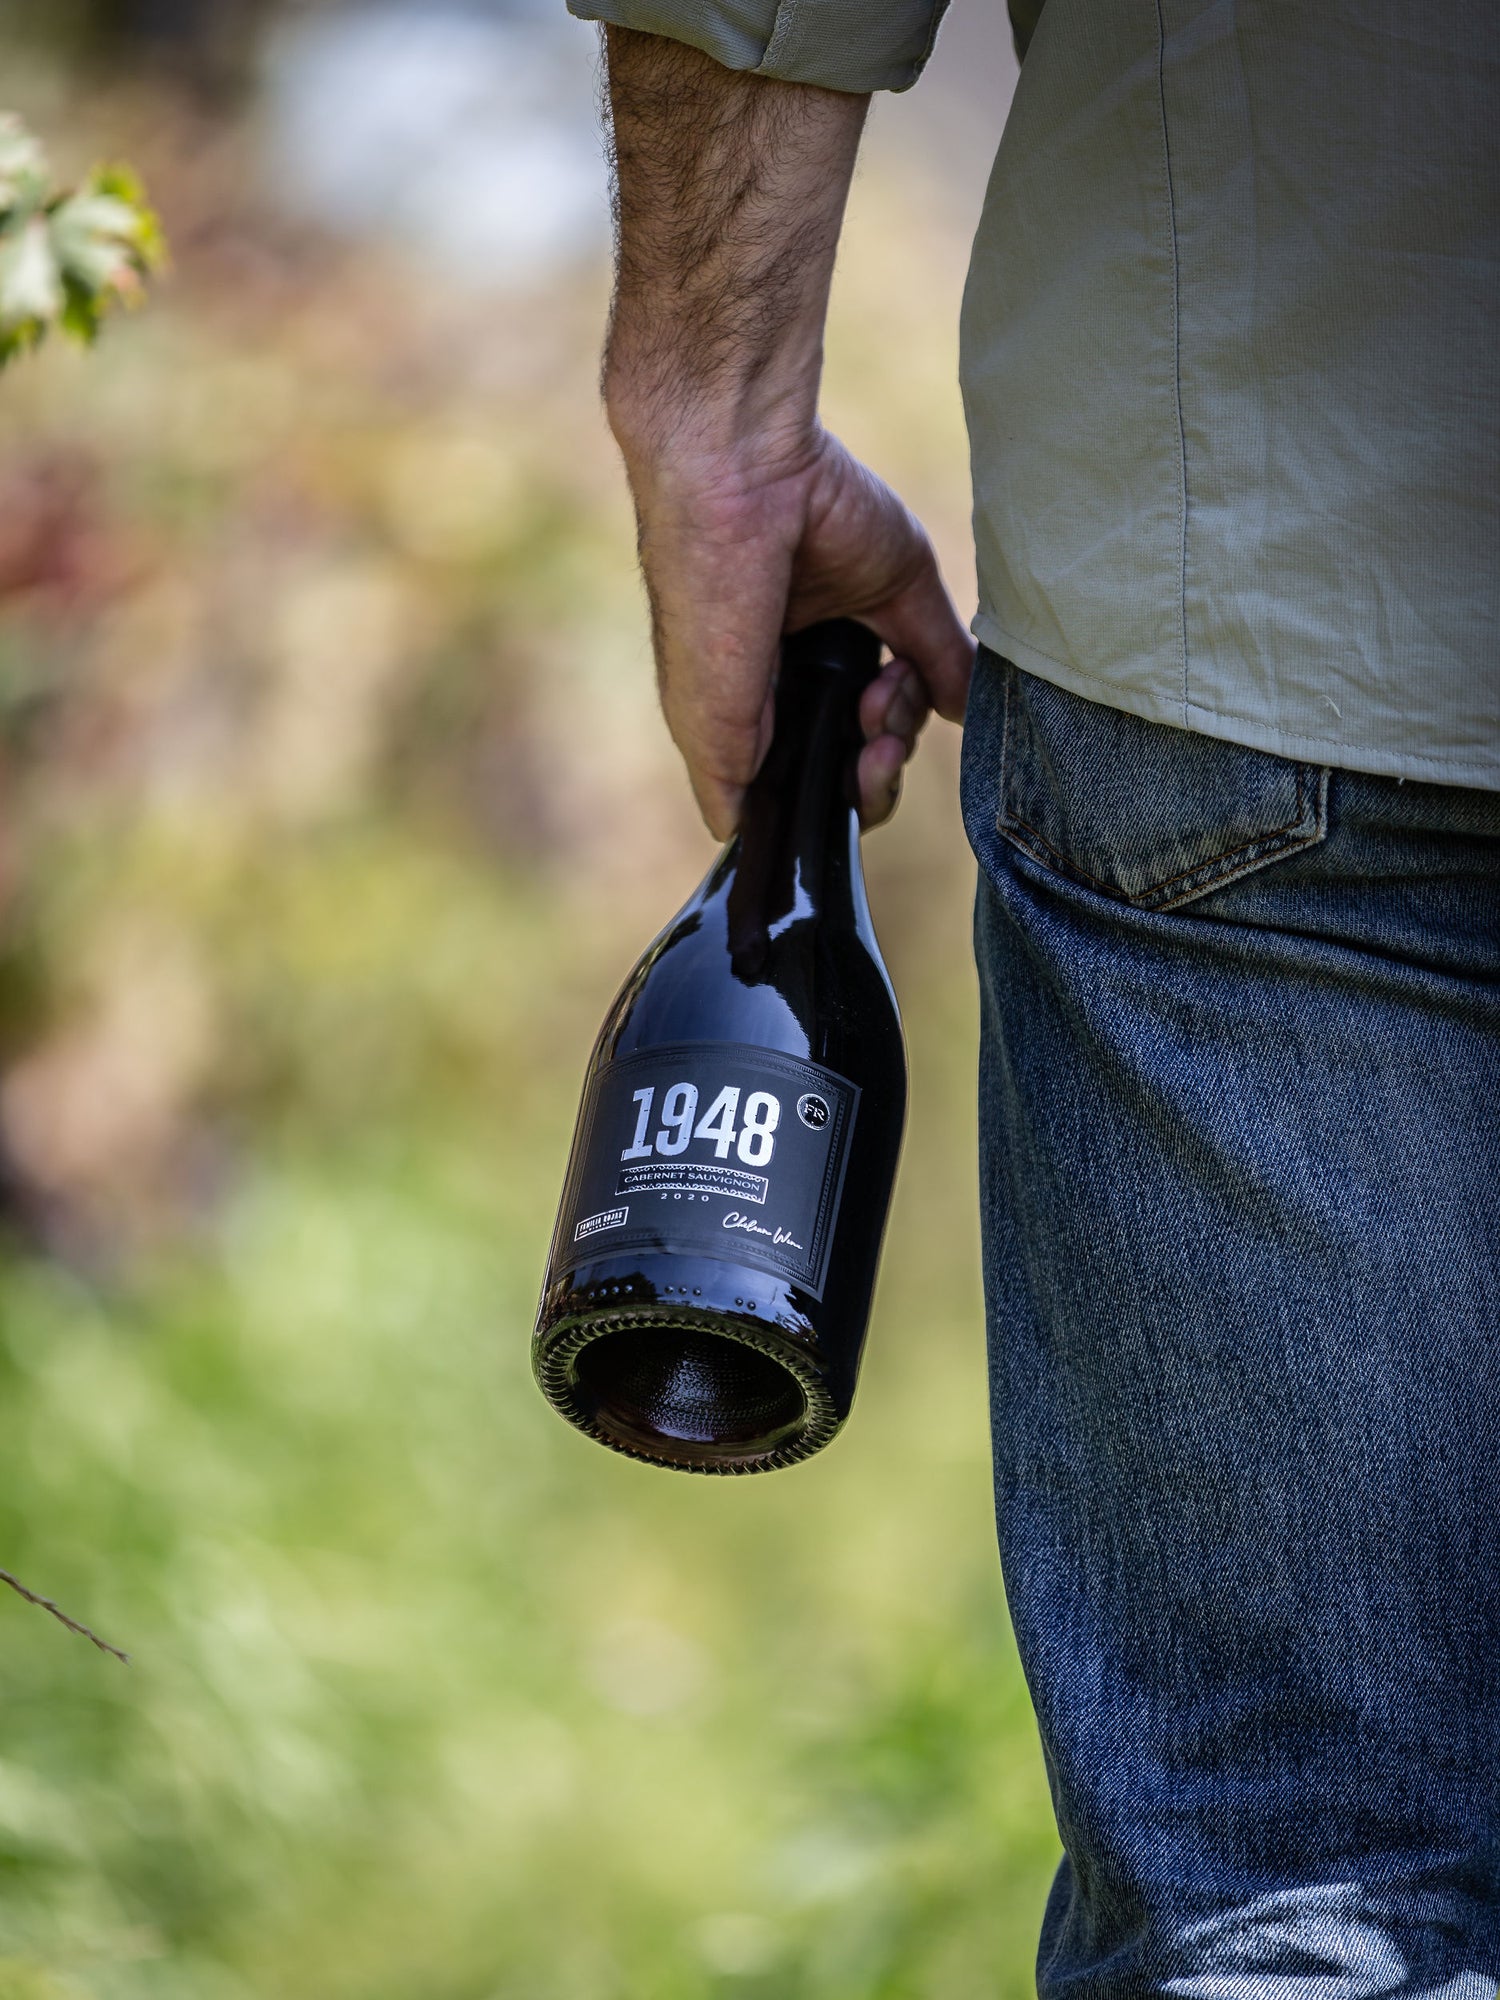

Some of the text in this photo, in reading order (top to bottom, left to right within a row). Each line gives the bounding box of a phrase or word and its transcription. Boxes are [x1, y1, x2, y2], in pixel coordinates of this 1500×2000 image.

[804, 1103, 824, 1121] FR
[620, 1082, 781, 1167] 1948
[624, 1172, 760, 1191] CABERNET SAUVIGNON
[660, 1192, 709, 1202] 2020
